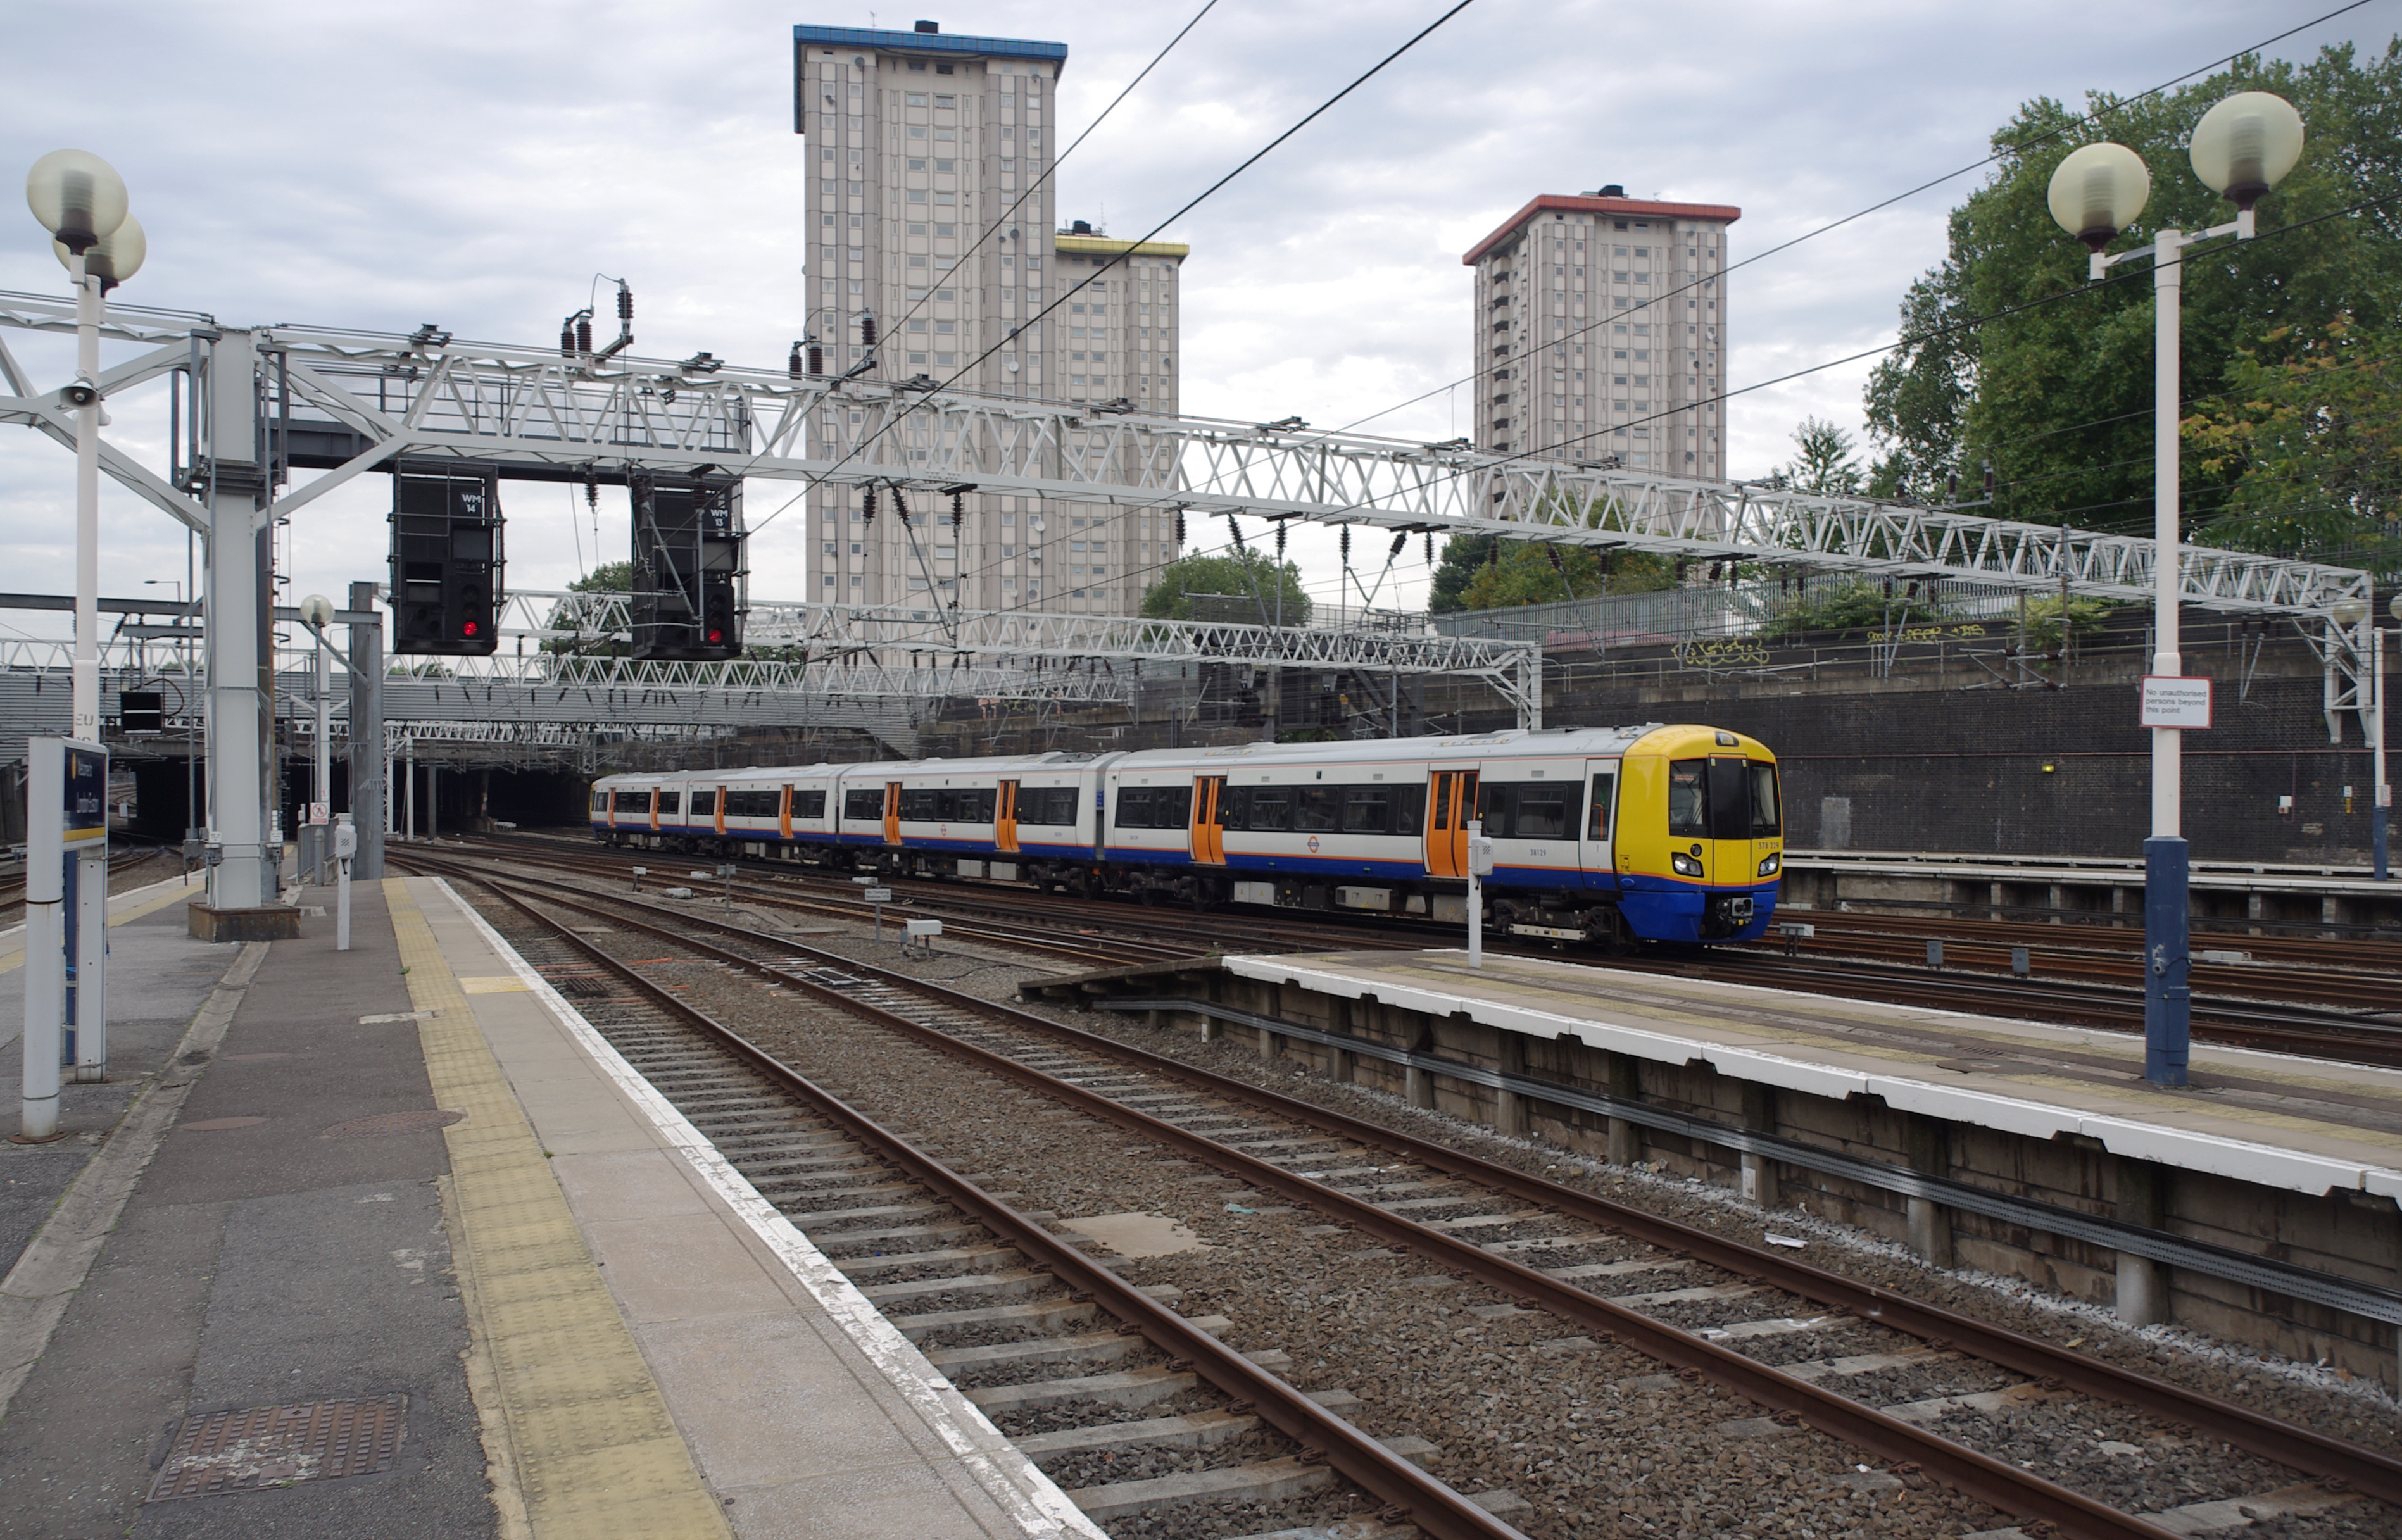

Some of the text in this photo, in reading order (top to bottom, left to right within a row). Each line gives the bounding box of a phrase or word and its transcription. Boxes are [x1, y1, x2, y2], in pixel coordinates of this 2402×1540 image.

[462, 494, 481, 503] WM
[467, 504, 476, 513] 14
[710, 509, 728, 517] WM
[2159, 689, 2206, 698] unauthorised
